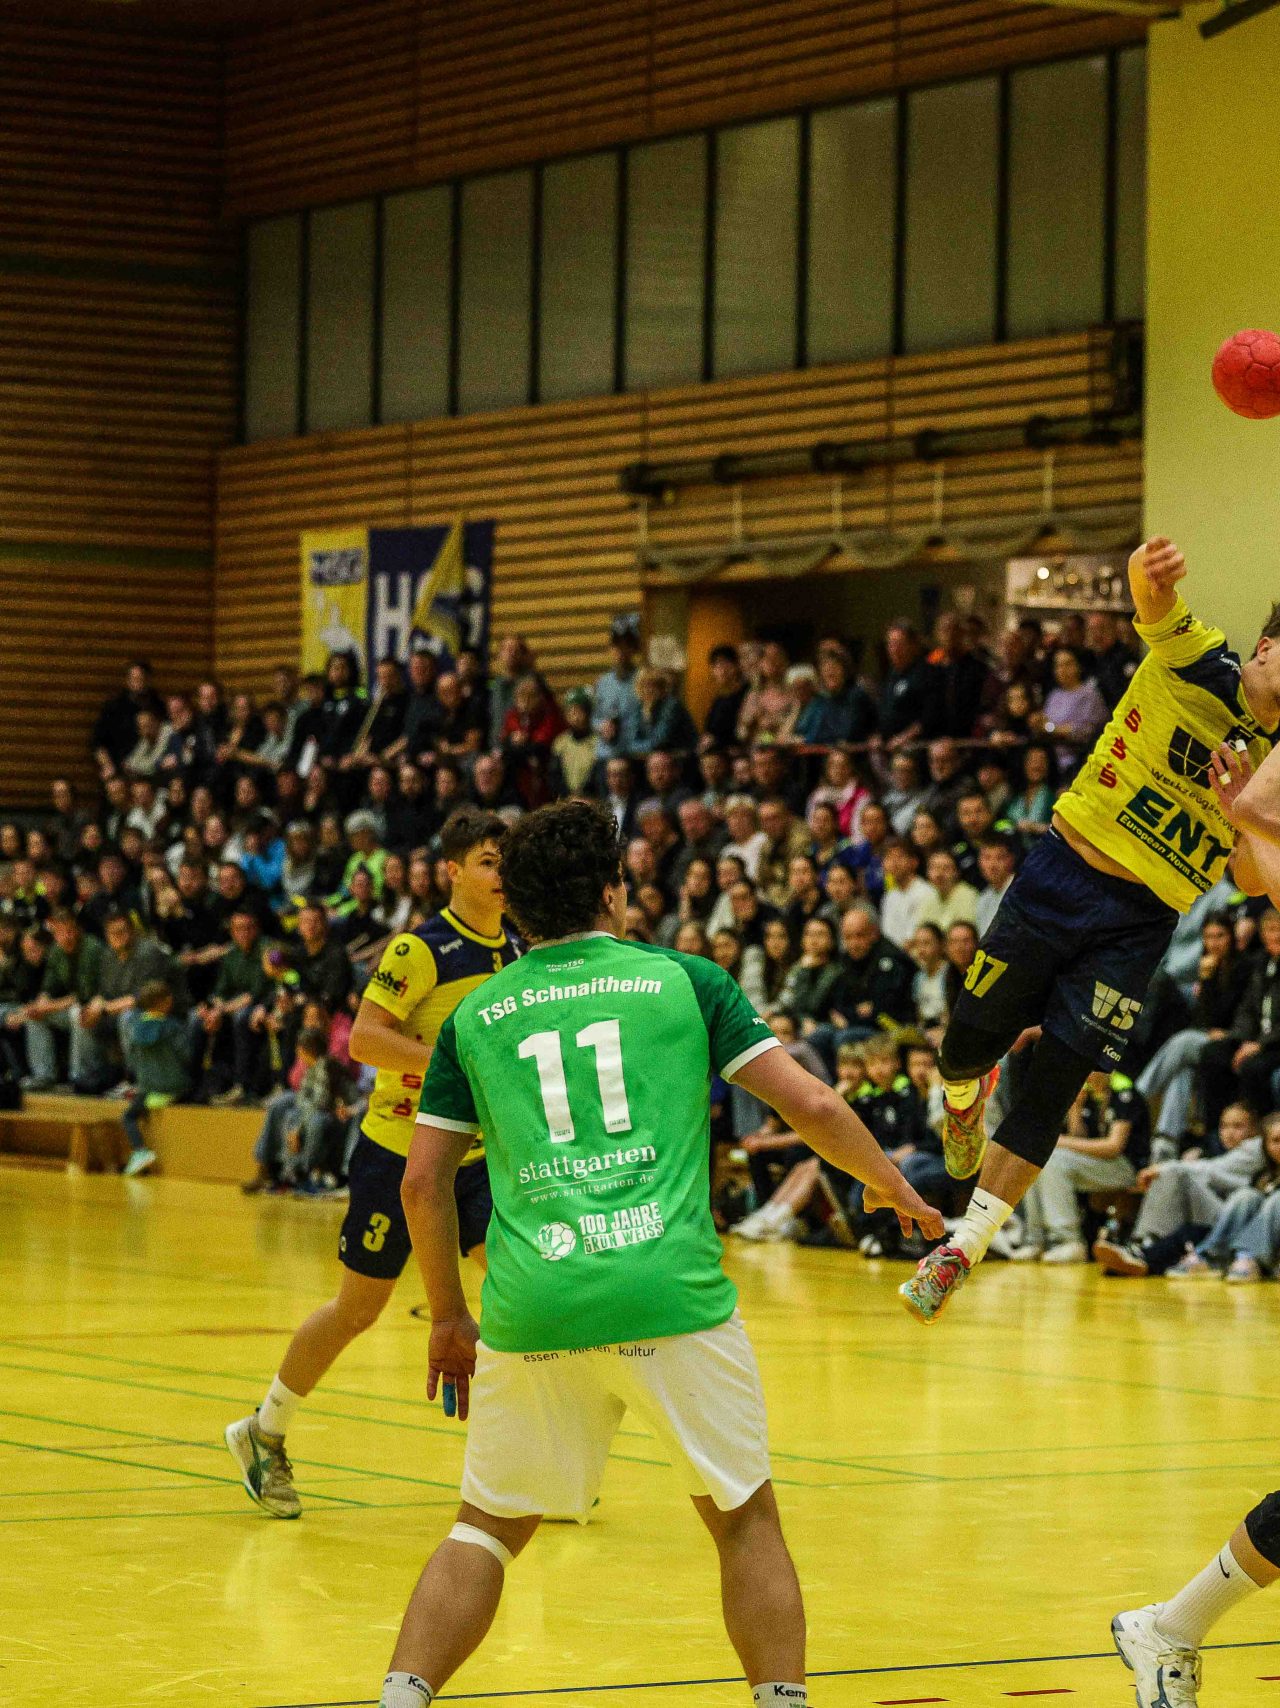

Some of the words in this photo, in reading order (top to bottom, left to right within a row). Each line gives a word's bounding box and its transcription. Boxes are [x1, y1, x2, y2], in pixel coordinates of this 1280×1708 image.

[1119, 814, 1167, 855] European
[1166, 851, 1191, 877] Norm
[1126, 785, 1233, 872] ENT
[477, 996, 518, 1025] TSG
[521, 976, 662, 1008] Schnaitheim
[518, 1018, 633, 1144] 11
[519, 1145, 657, 1184] stattgarten
[531, 1173, 655, 1204] www.stattgarten.de
[363, 1212, 391, 1252] 3
[578, 1213, 607, 1236] 100
[610, 1201, 662, 1232] JAHRE
[584, 1232, 618, 1254] GRÜN
[623, 1220, 664, 1245] WEISS
[523, 1351, 559, 1363] essen
[618, 1345, 657, 1358] kultur
